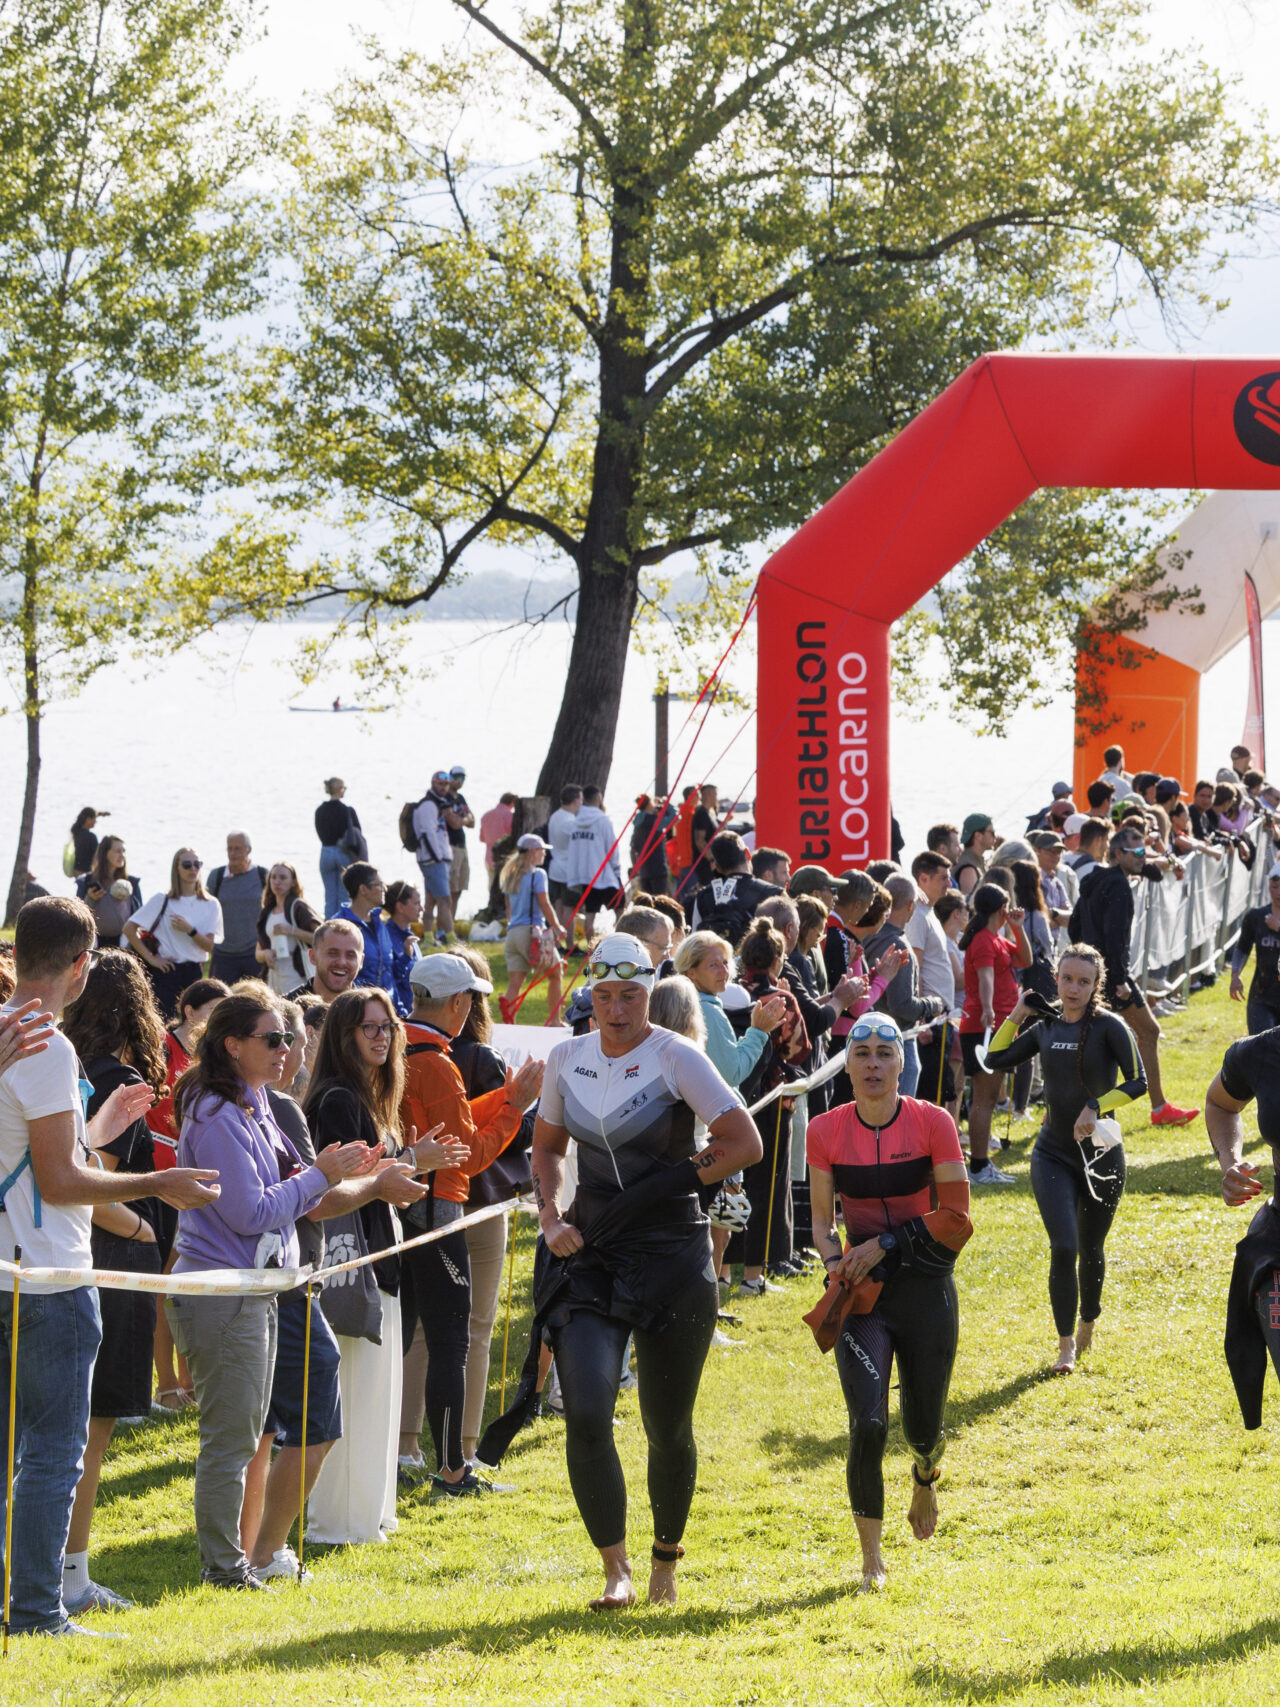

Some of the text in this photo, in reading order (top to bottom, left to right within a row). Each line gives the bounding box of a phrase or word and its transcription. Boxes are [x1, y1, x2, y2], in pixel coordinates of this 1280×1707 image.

[1051, 1042, 1079, 1050] ZONE
[573, 1066, 598, 1079] AGATA
[624, 1072, 640, 1080] POL
[842, 1331, 880, 1380] reaction
